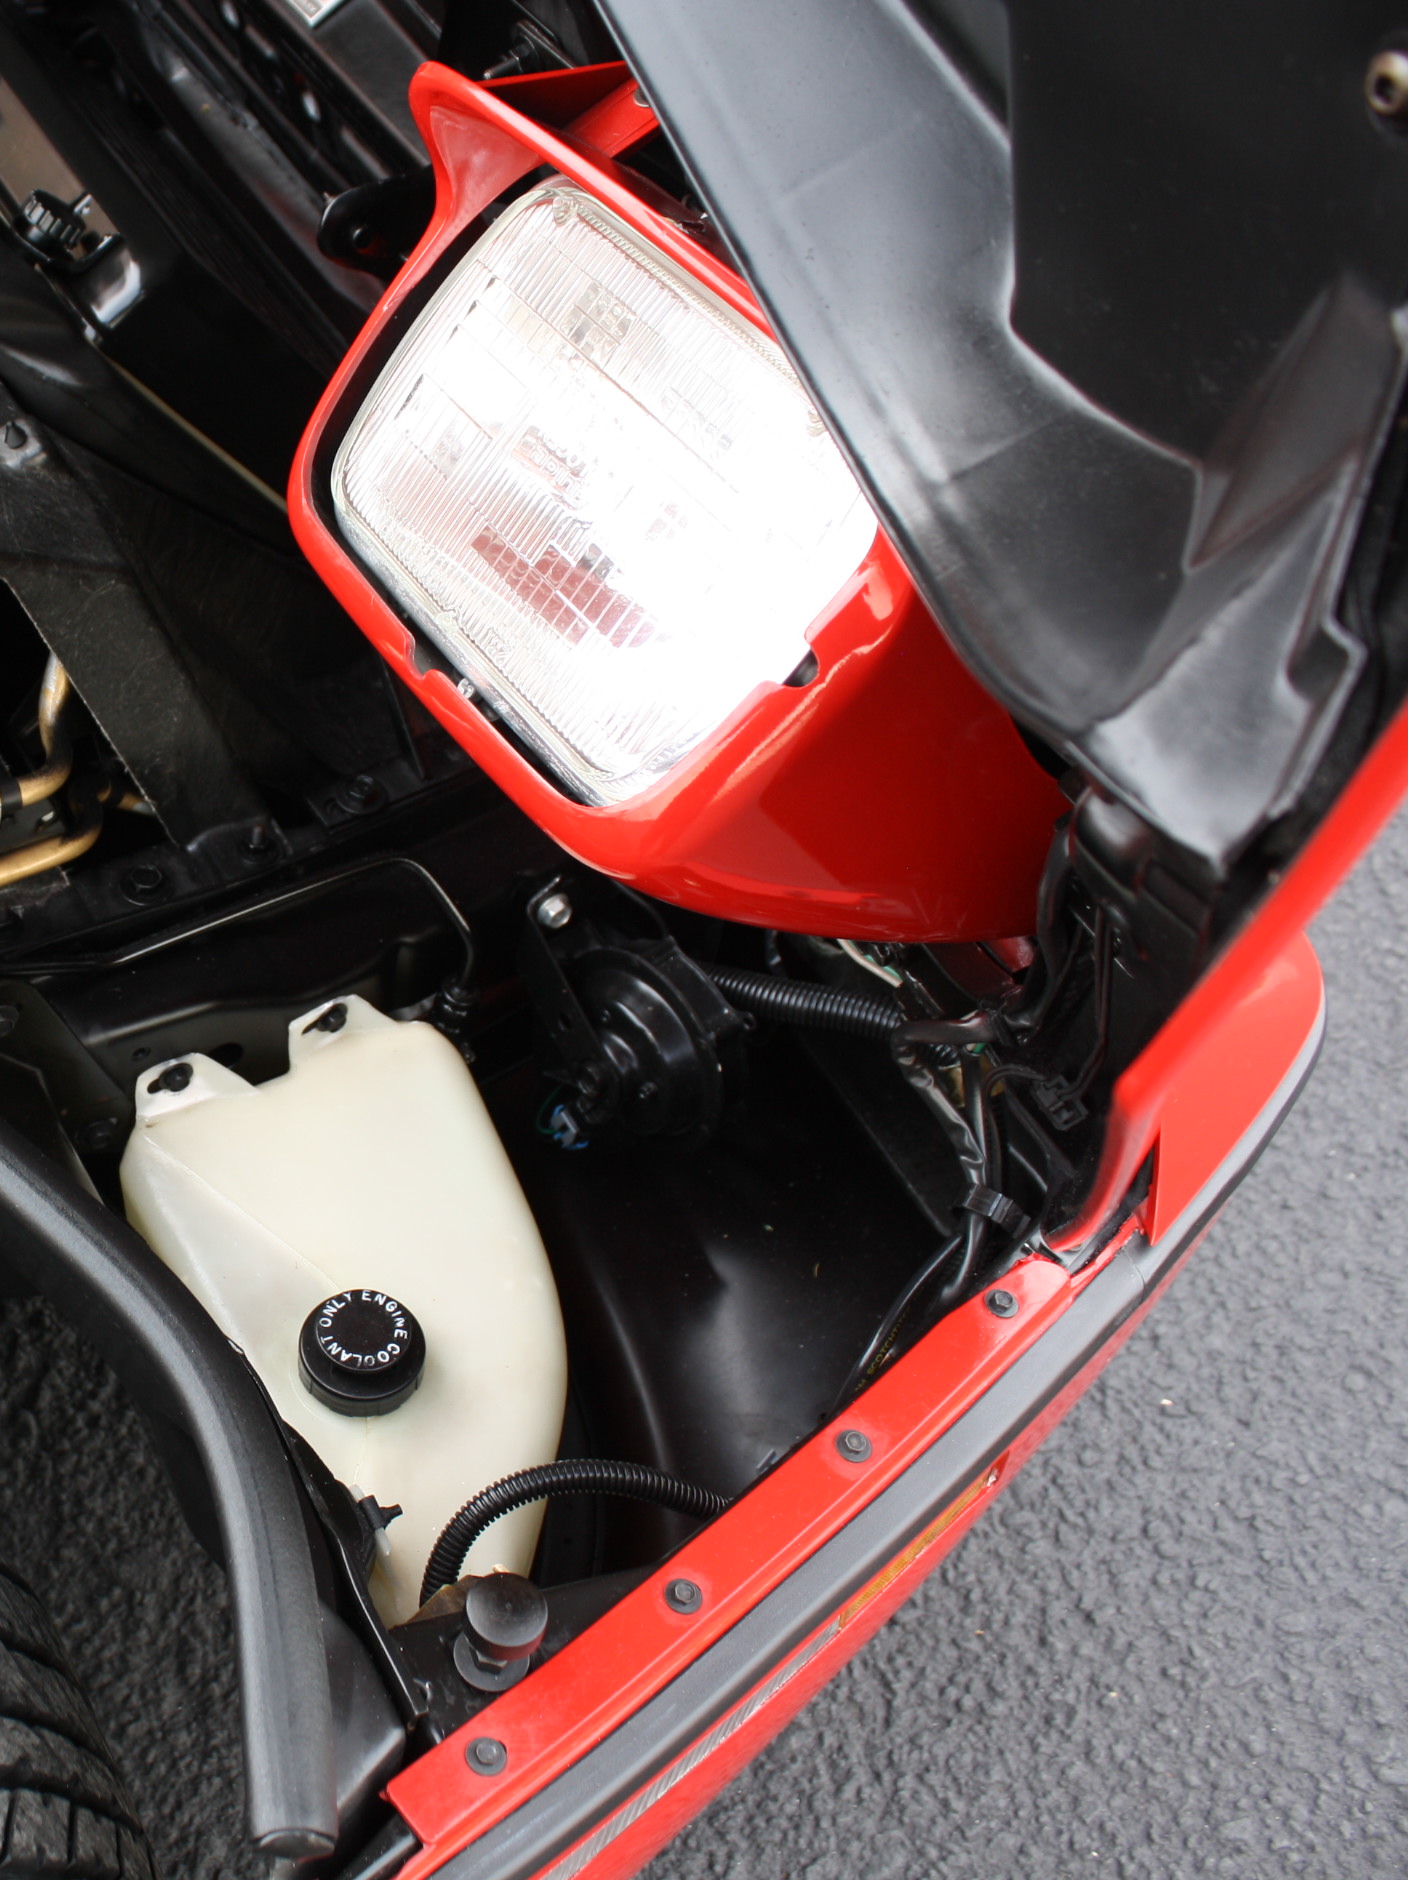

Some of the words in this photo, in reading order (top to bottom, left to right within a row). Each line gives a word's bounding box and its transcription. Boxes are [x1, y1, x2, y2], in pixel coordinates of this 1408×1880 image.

[319, 1292, 352, 1328] ONLY
[361, 1289, 408, 1340] ENGINE
[320, 1335, 401, 1368] COOLANT
